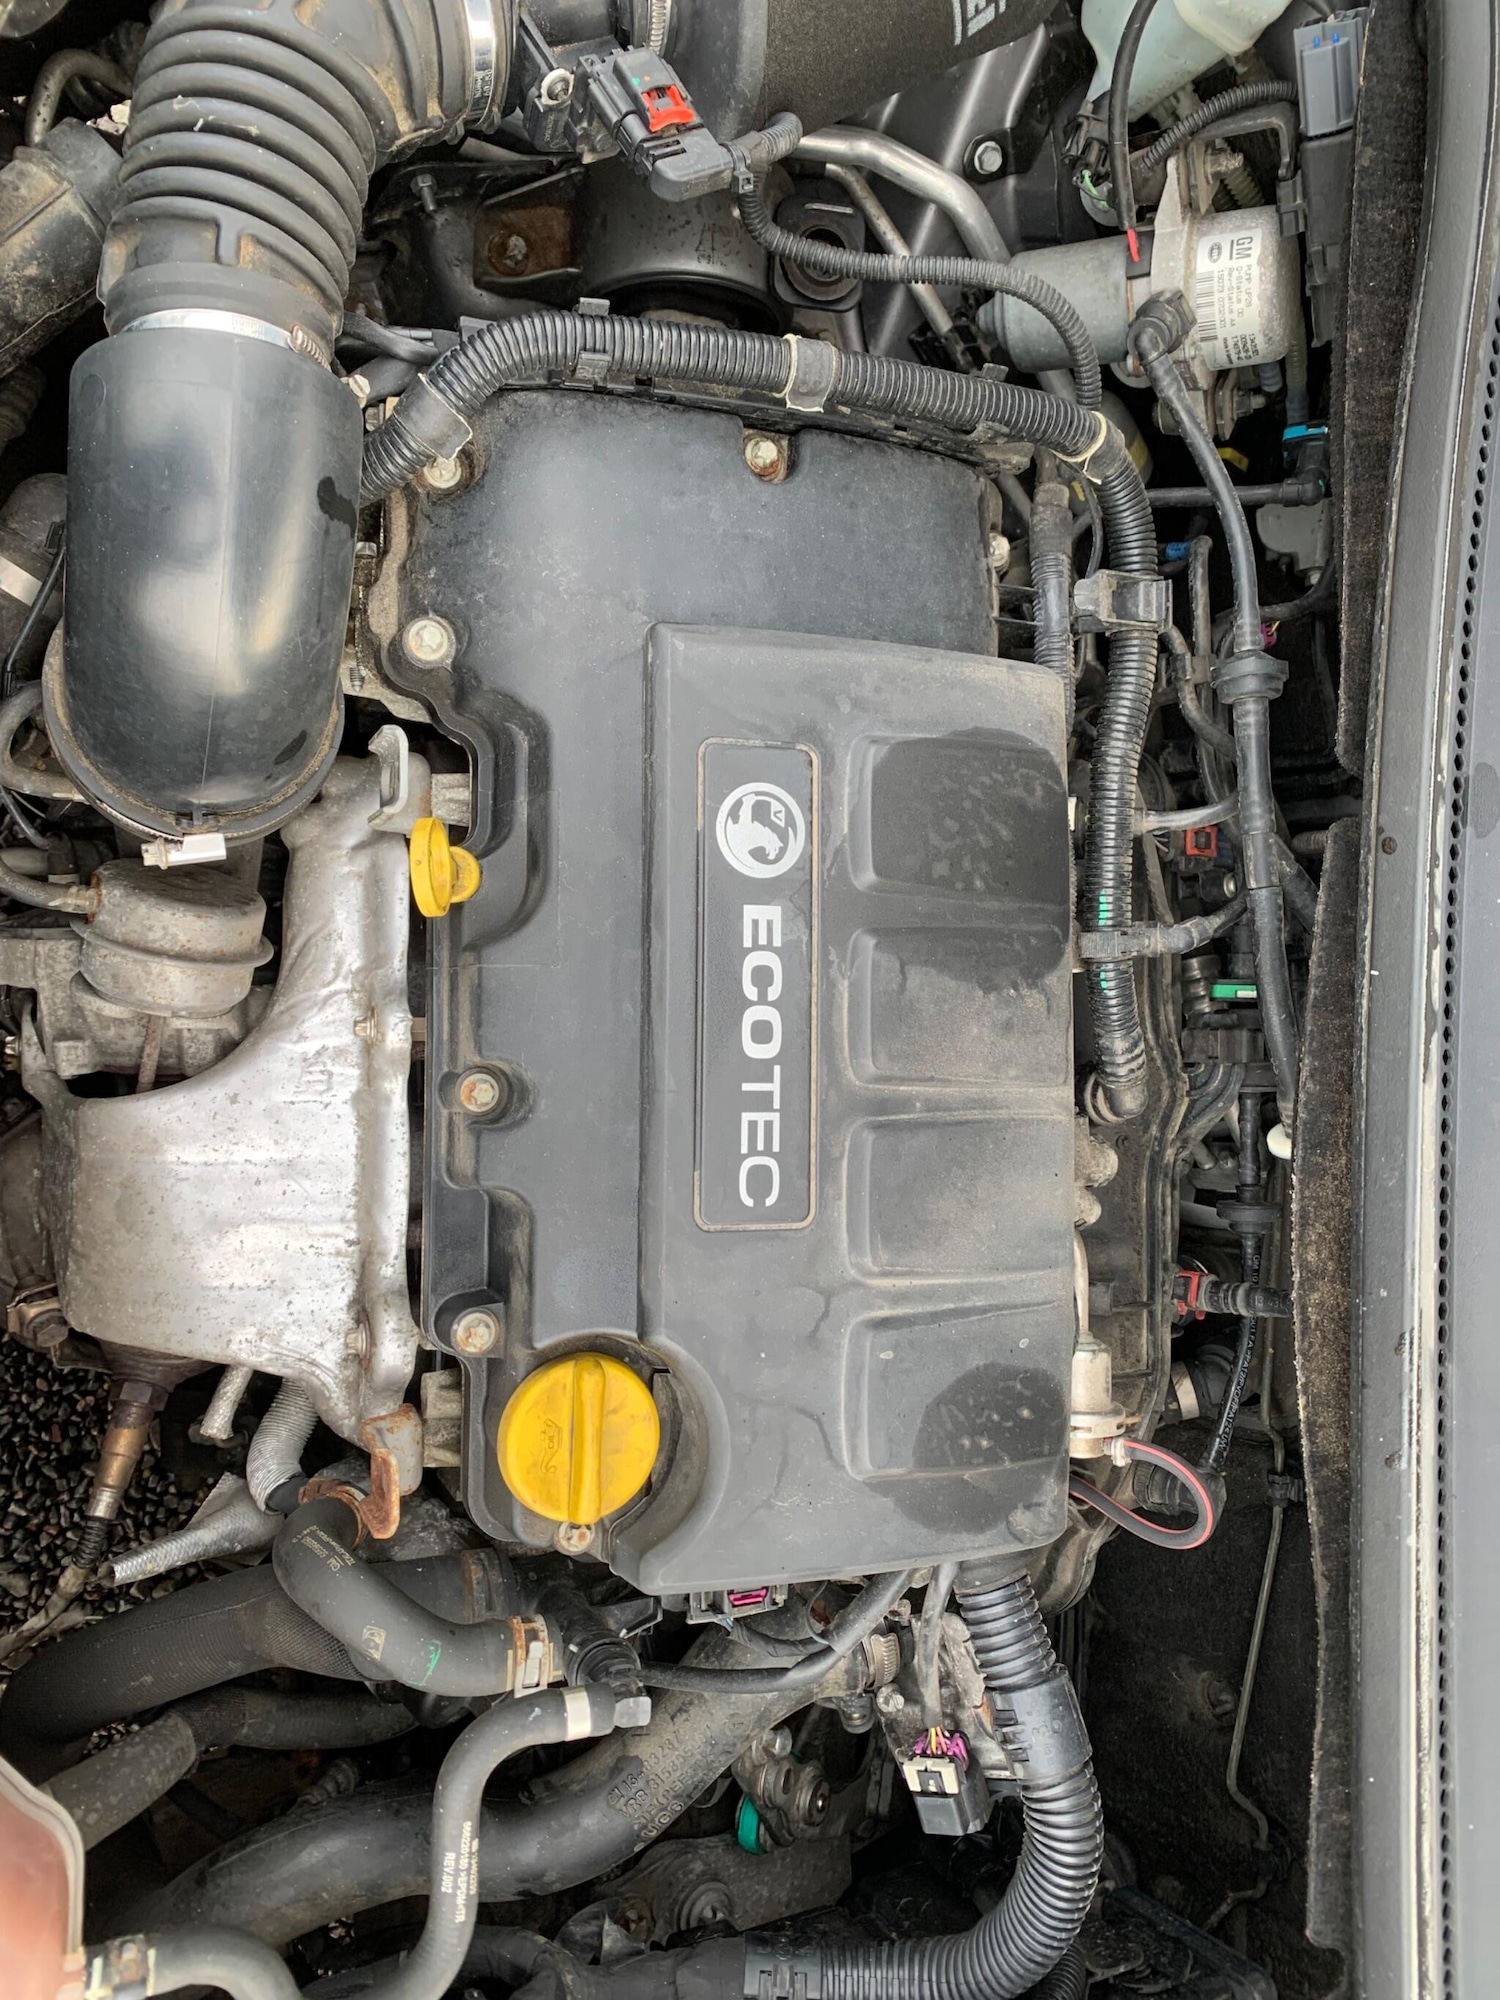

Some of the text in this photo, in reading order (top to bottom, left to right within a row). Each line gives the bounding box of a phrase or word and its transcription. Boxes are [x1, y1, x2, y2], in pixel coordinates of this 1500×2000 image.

[1235, 236, 1253, 260] GM
[1245, 264, 1253, 308] PUMP UP28
[738, 904, 783, 1208] ECOTEC
[1252, 1254, 1260, 1270] GM
[619, 1789, 649, 1818] VRB
[441, 1852, 456, 1894] REV.002
